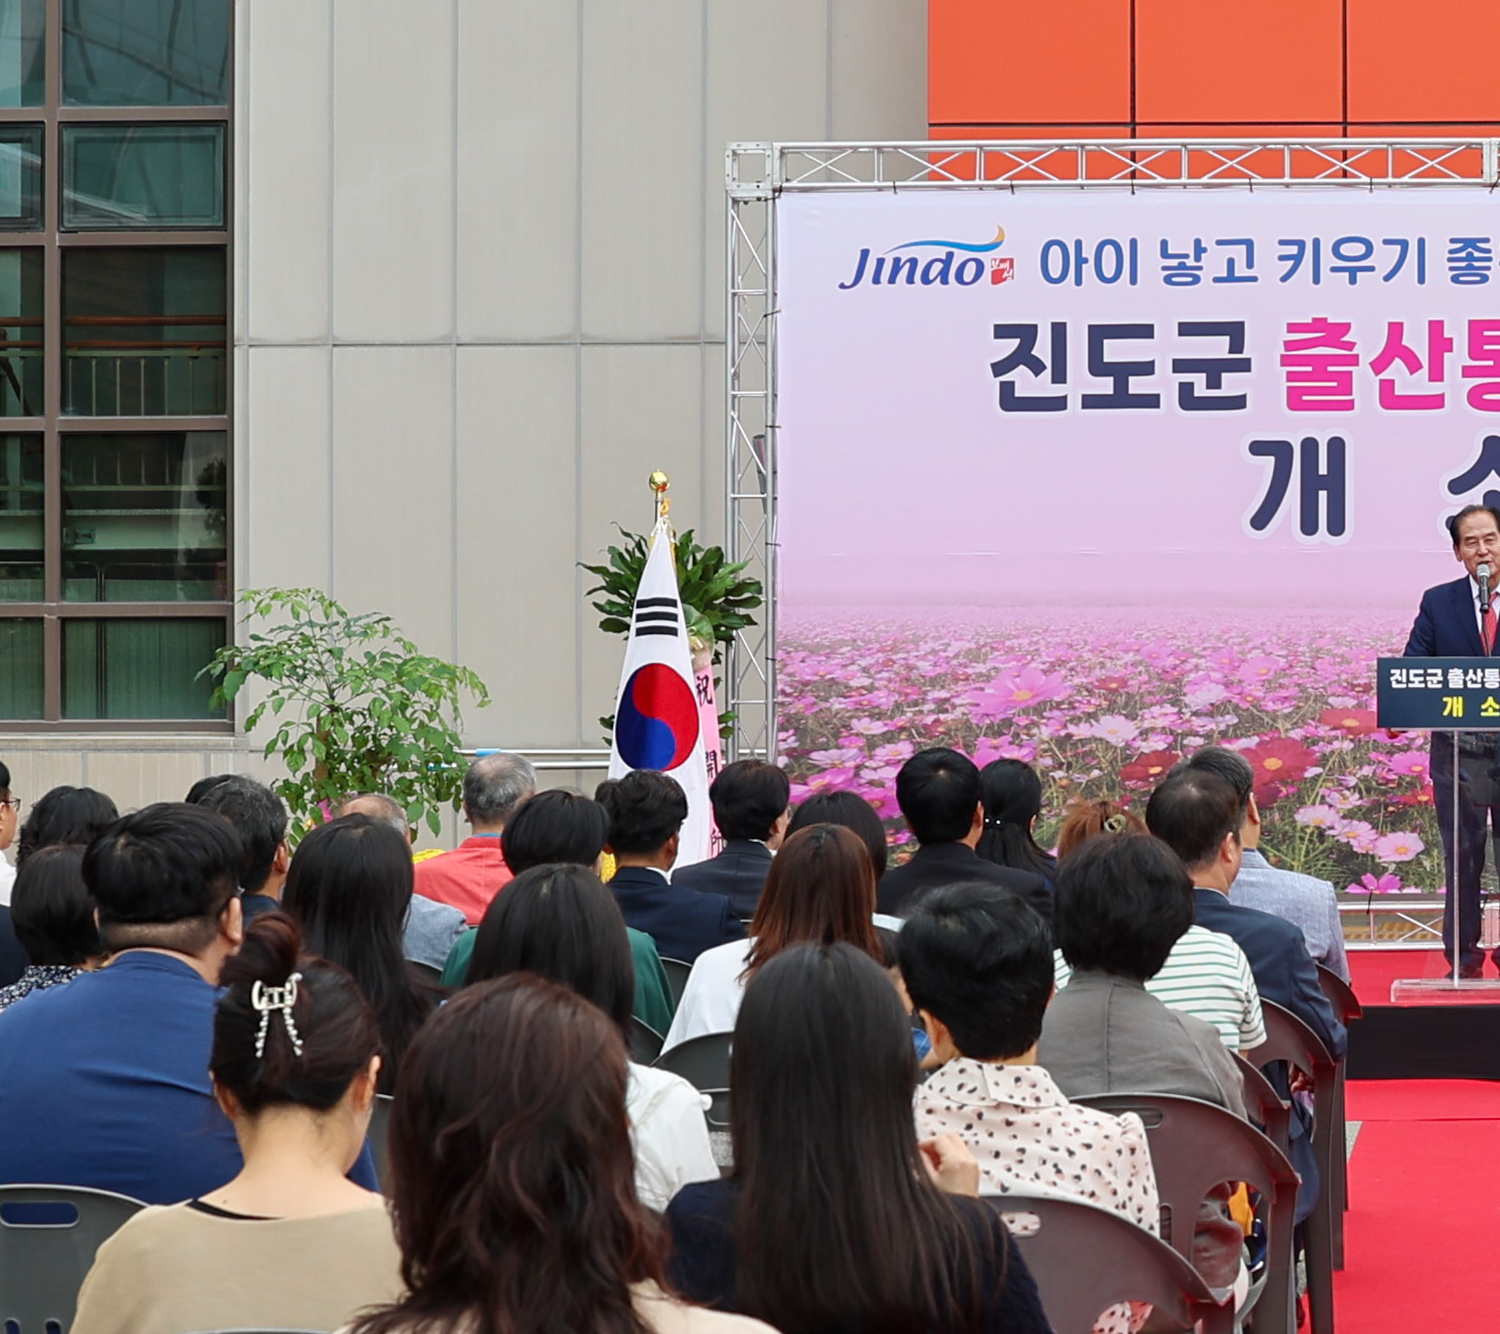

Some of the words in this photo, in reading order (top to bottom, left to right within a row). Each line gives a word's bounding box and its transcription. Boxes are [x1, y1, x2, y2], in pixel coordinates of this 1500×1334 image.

[838, 248, 985, 290] Jindo
[1040, 238, 1138, 287] 아이
[1159, 238, 1258, 286] 낳고
[1277, 237, 1427, 285] 키우기
[990, 321, 1252, 412] 진도군
[1390, 669, 1443, 689] 진도군
